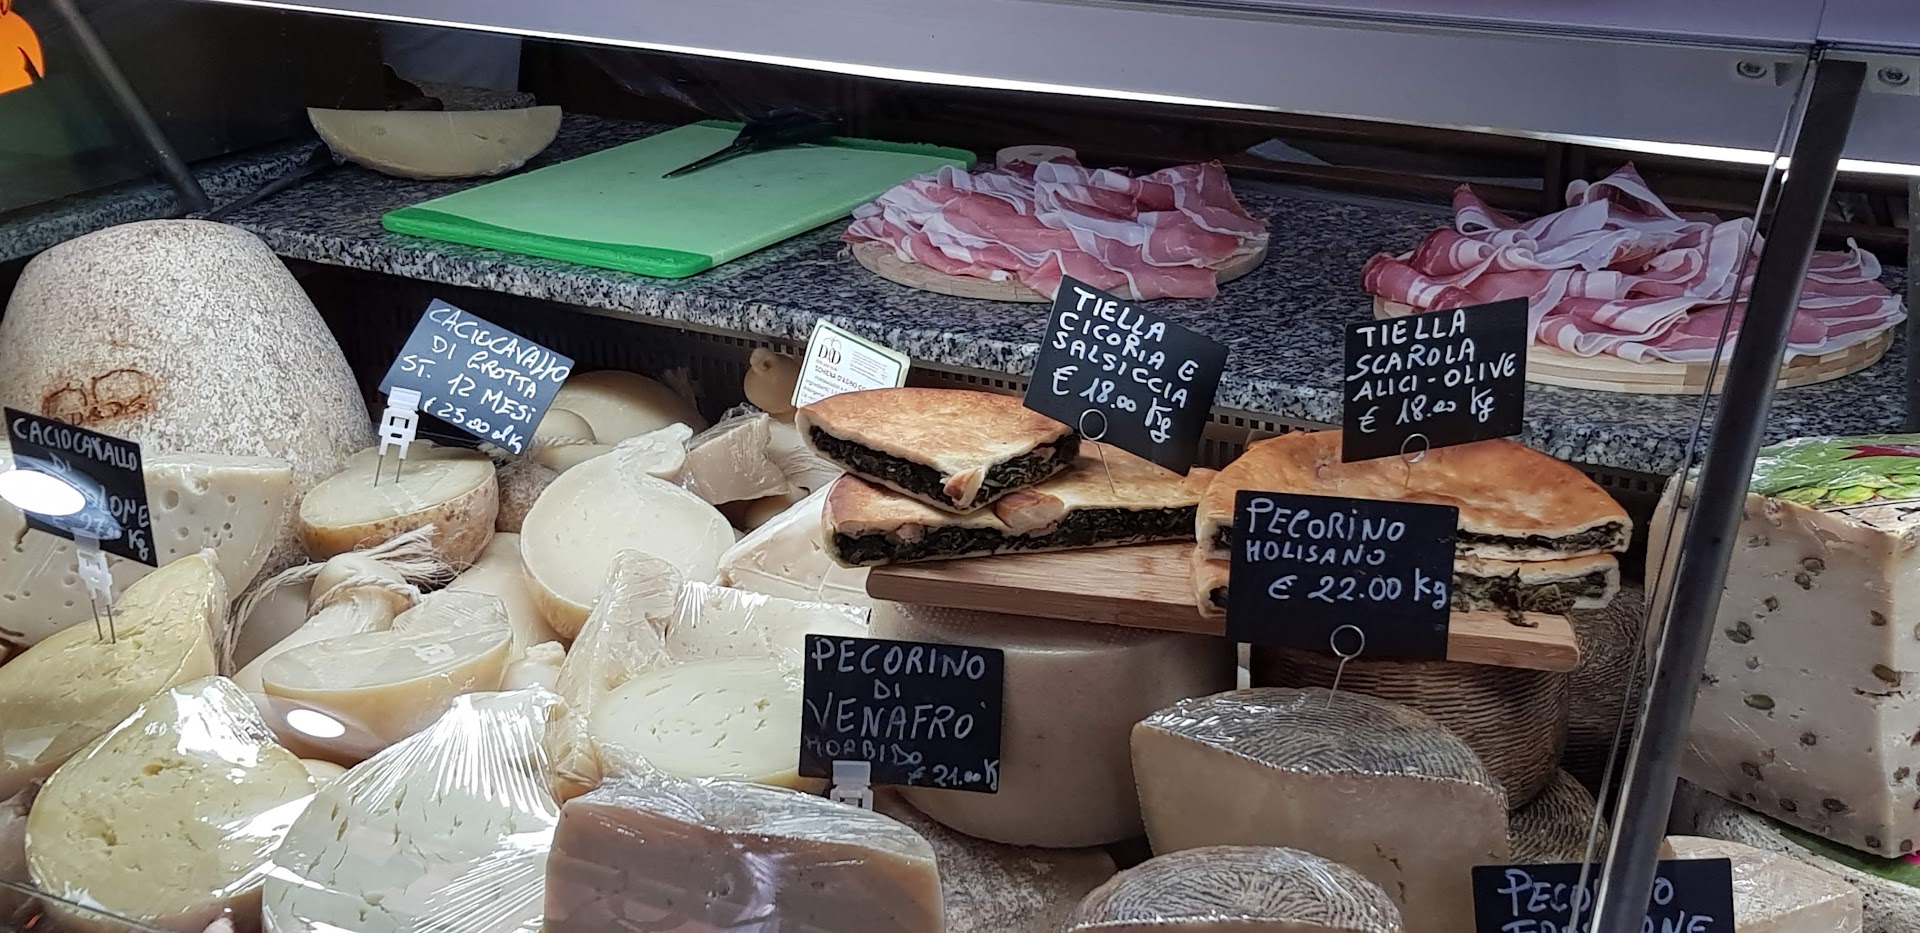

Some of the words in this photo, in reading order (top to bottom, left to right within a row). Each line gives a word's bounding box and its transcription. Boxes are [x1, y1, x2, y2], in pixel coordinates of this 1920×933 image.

[1073, 286, 1166, 342] TIELLA
[1356, 309, 1465, 347] TIELLA
[432, 335, 457, 360] DI
[1059, 311, 1165, 370] CICORIA
[1178, 360, 1199, 381] E
[1346, 337, 1475, 381] SCAROLA
[401, 354, 436, 379] ST.
[447, 372, 476, 397] 12
[1052, 331, 1188, 409] SALSICCIA
[1052, 365, 1078, 395] €
[1079, 377, 1137, 413] 18.00
[1144, 397, 1173, 444] Kg
[1358, 406, 1379, 433] €
[1395, 394, 1456, 425] 18.00
[1470, 385, 1495, 423] Kg
[12, 418, 138, 471] CACIOCAVALLO
[1246, 497, 1405, 541] PECORINO
[1268, 574, 1298, 600] €
[1307, 575, 1401, 603] 22.00
[811, 637, 985, 680] PECORINO
[873, 678, 901, 699] DI
